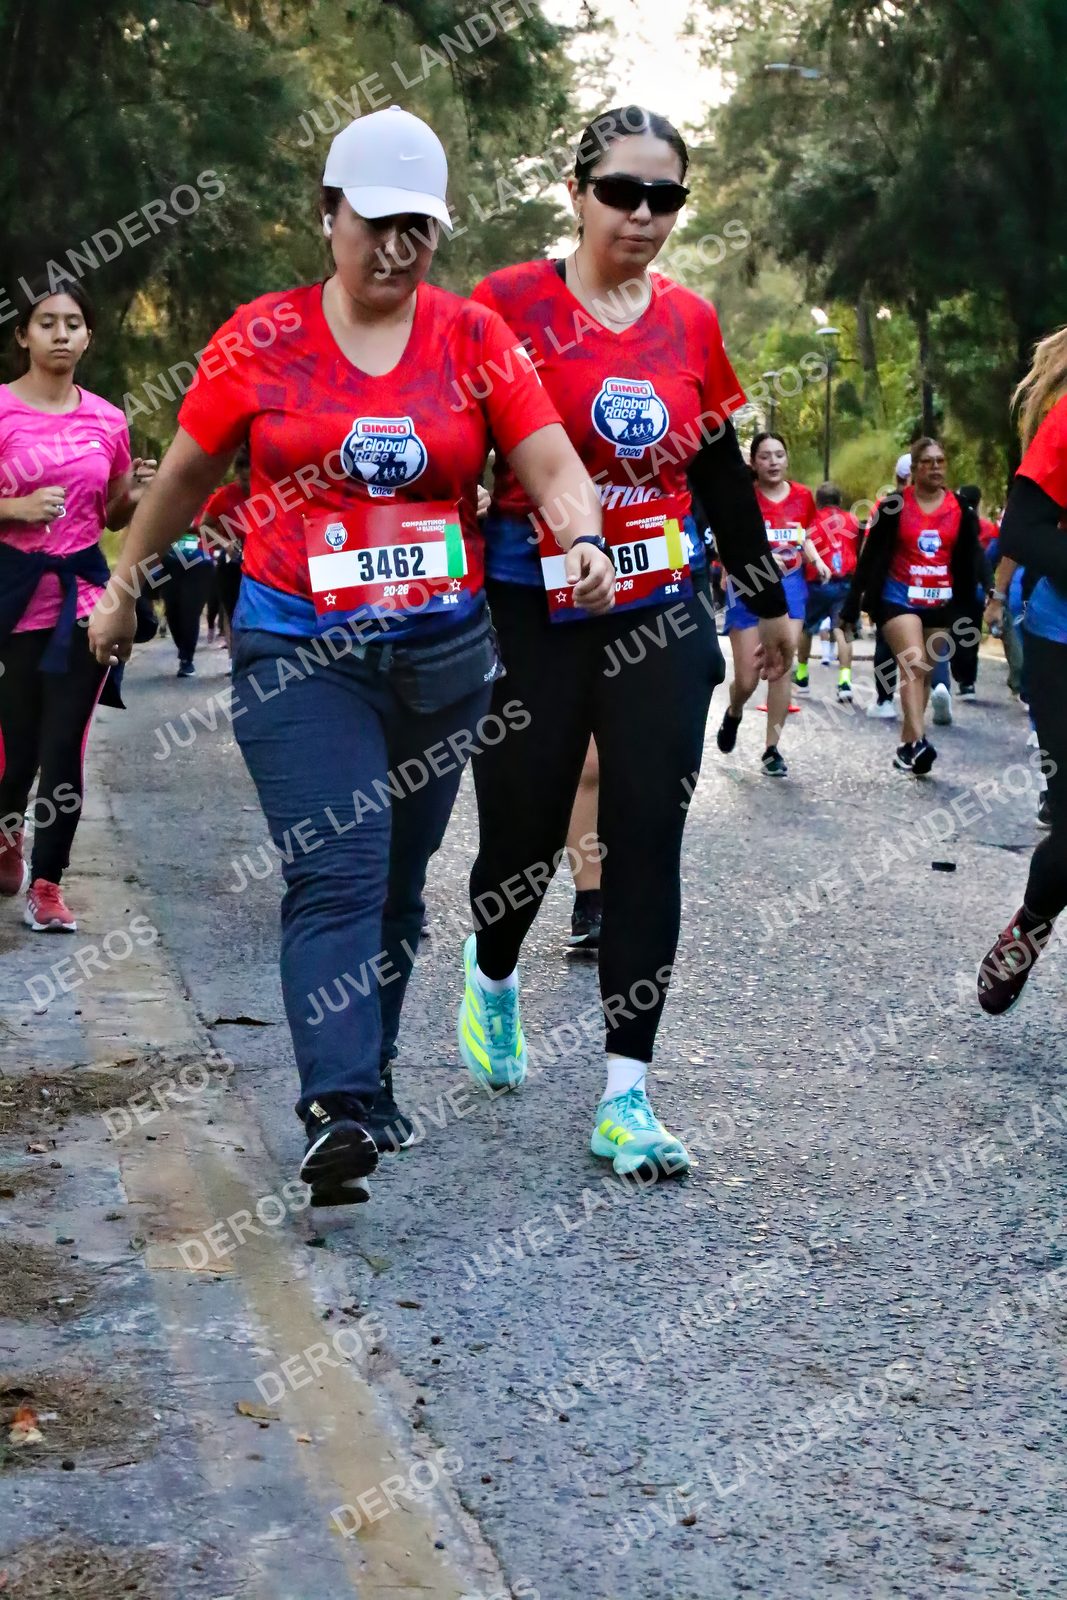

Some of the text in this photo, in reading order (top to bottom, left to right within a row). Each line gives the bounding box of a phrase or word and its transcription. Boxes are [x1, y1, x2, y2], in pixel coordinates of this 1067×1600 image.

[610, 384, 649, 395] BIMBO
[612, 396, 650, 410] Global
[603, 405, 637, 420] Race
[361, 423, 407, 434] BIMBO
[362, 438, 407, 453] Global
[617, 447, 643, 458] 2026
[353, 449, 390, 463] Race
[357, 545, 426, 582] 3462
[615, 542, 649, 575] 60
[664, 583, 680, 595] 5K
[442, 594, 459, 604] 5K
